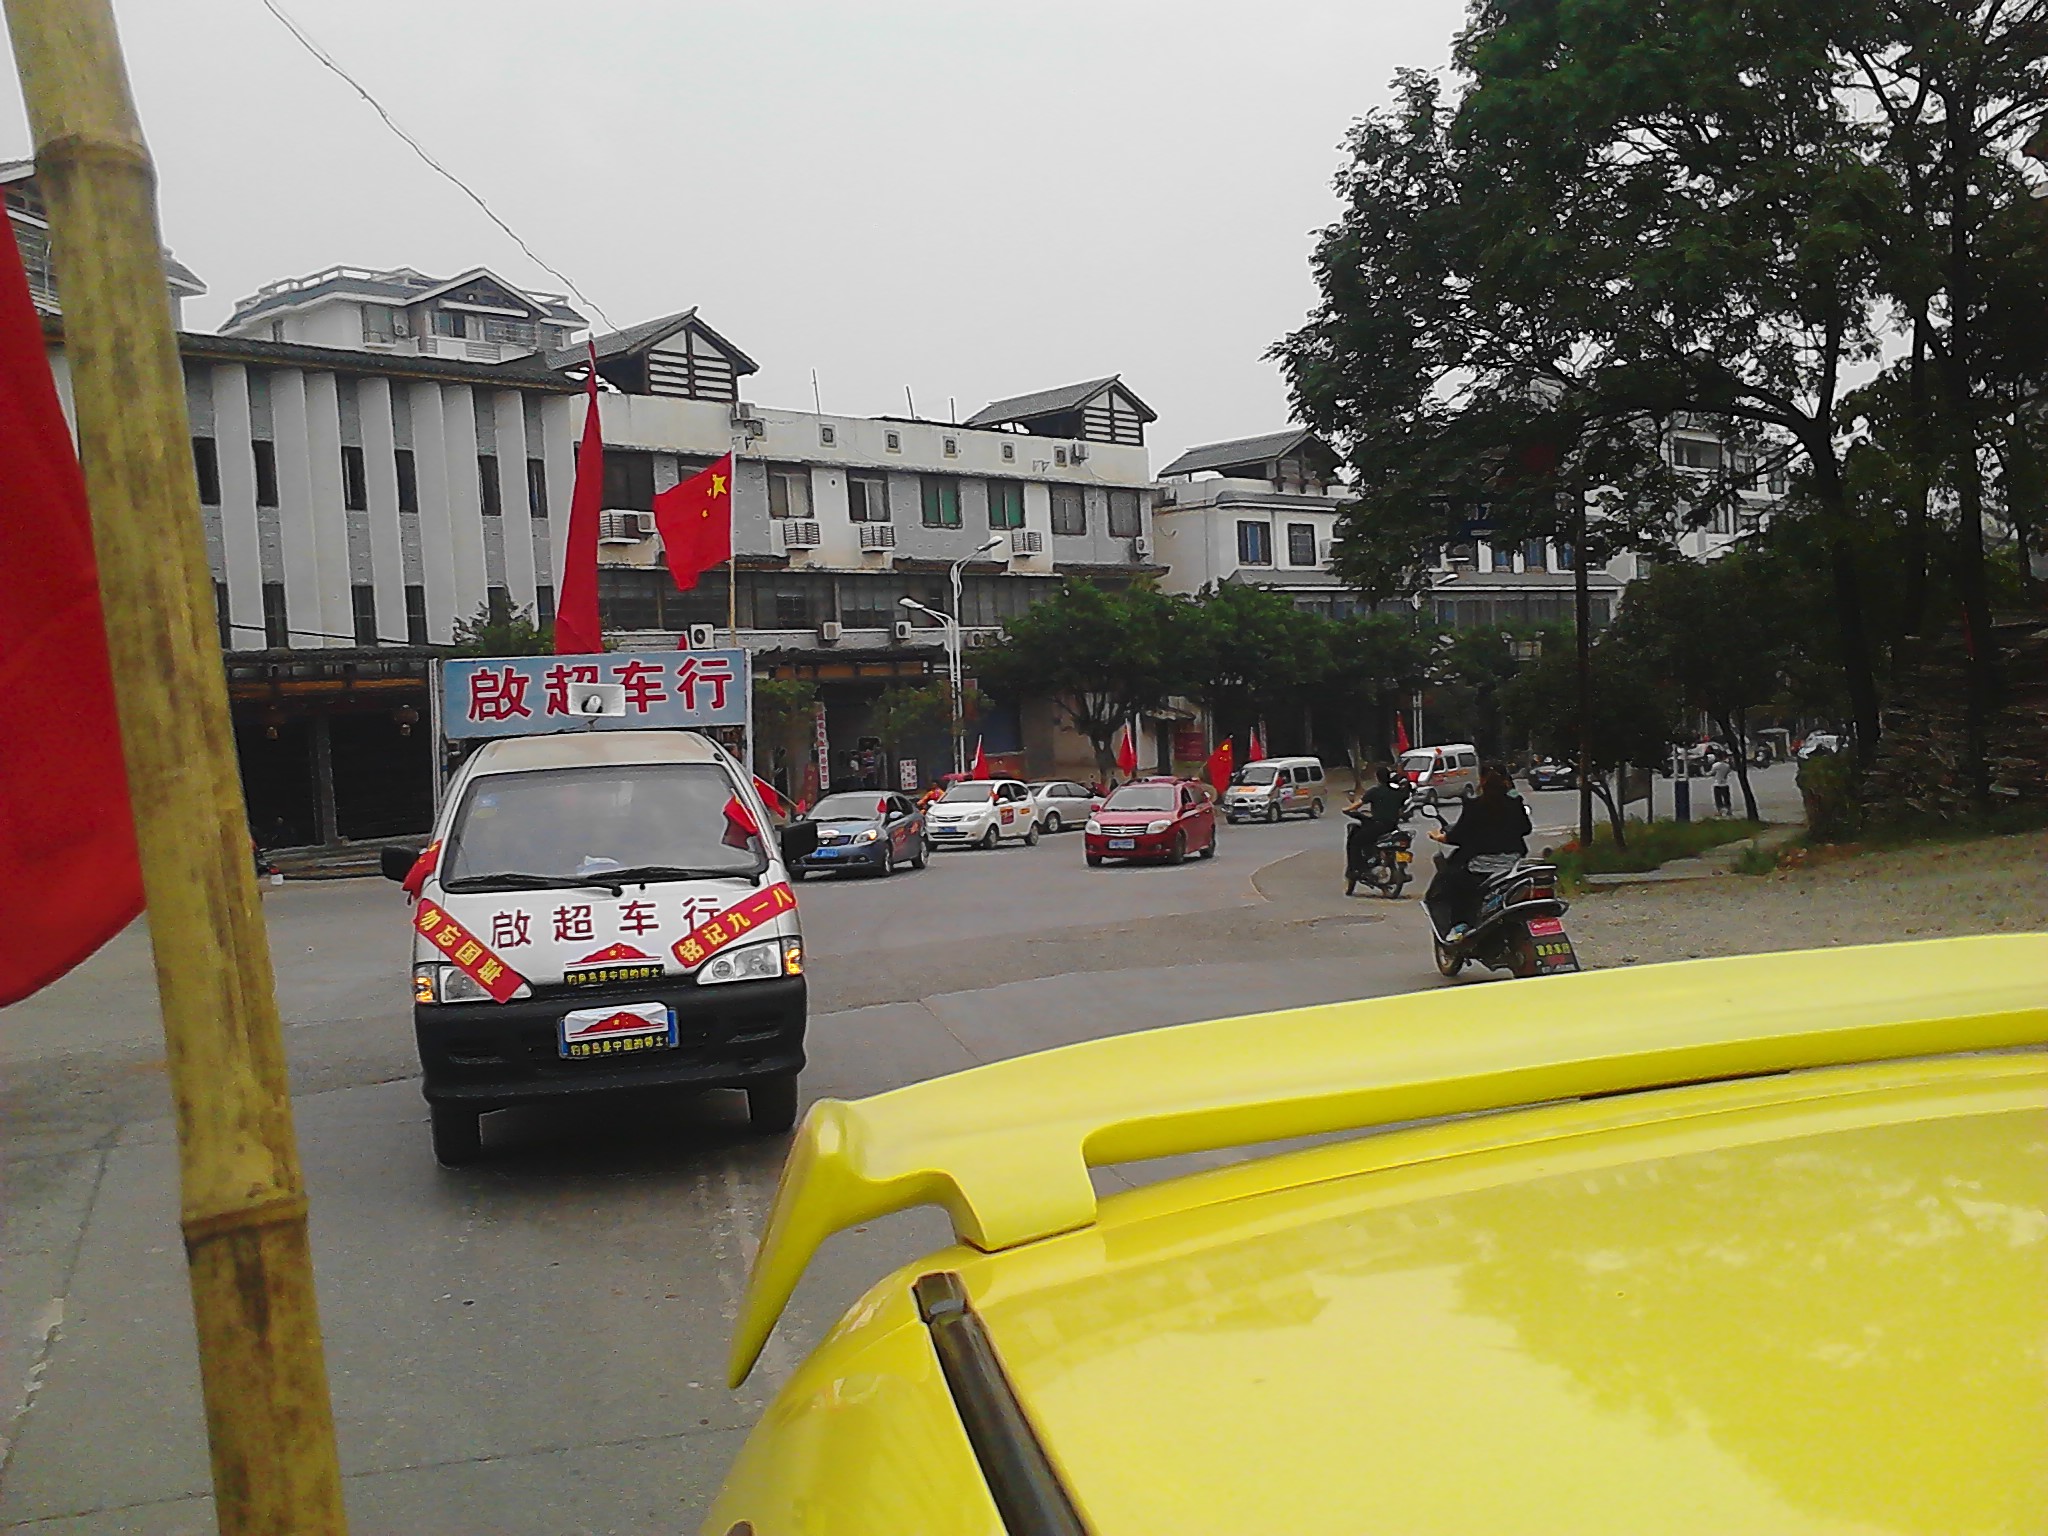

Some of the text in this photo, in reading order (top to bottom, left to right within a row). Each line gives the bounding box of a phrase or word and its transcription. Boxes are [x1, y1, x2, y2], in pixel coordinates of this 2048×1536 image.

[420, 909, 504, 986] 勿忘国耻
[678, 887, 793, 961] 铭记九一八
